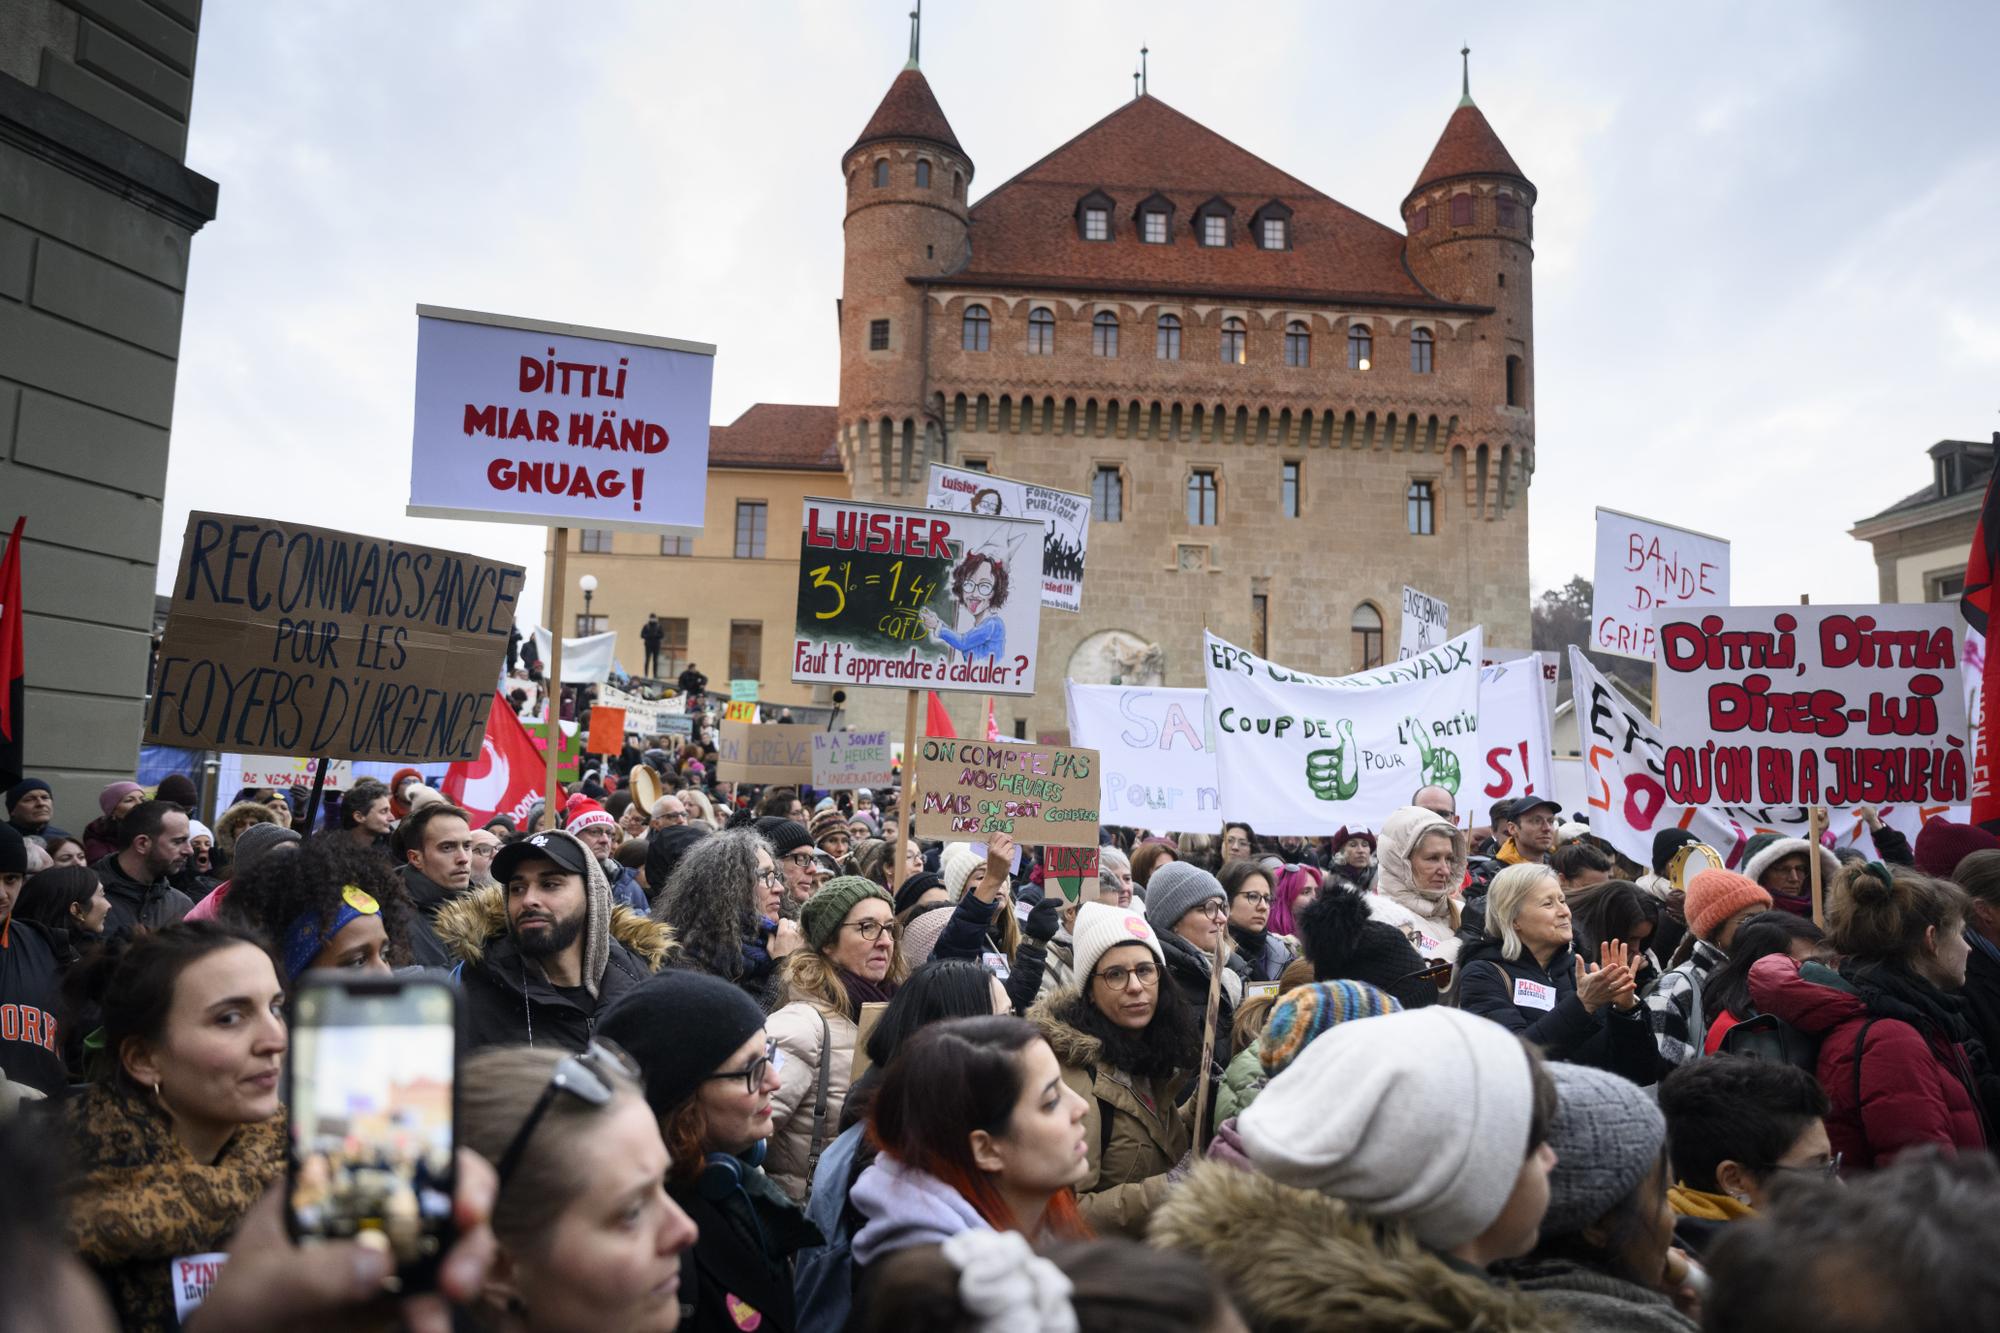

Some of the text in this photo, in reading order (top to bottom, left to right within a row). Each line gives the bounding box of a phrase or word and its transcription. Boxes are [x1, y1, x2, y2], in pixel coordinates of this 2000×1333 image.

[463, 404, 670, 454] MIAR HÄND
[1624, 533, 1719, 600] BANDE
[272, 617, 408, 670] POUR LES
[795, 641, 829, 675] Faut
[834, 644, 932, 684] t'apprendre
[935, 657, 946, 675] à
[150, 657, 494, 759] FOYERS D'URGENCE
[1218, 707, 1332, 739] COUP DE
[720, 737, 739, 761] EN
[814, 735, 826, 750] IL
[831, 737, 840, 750] A
[922, 741, 1091, 780] ON COMPTE PAS
[1362, 749, 1407, 770] POUR
[242, 771, 258, 784] DE
[958, 767, 1065, 803] NOS HEURES
[1663, 739, 1753, 806] QU'ON
[1757, 746, 1794, 805] EN
[1799, 747, 1819, 806] A
[922, 791, 972, 816] MAIS
[977, 799, 1002, 816] ON
[951, 816, 981, 833] NOS
